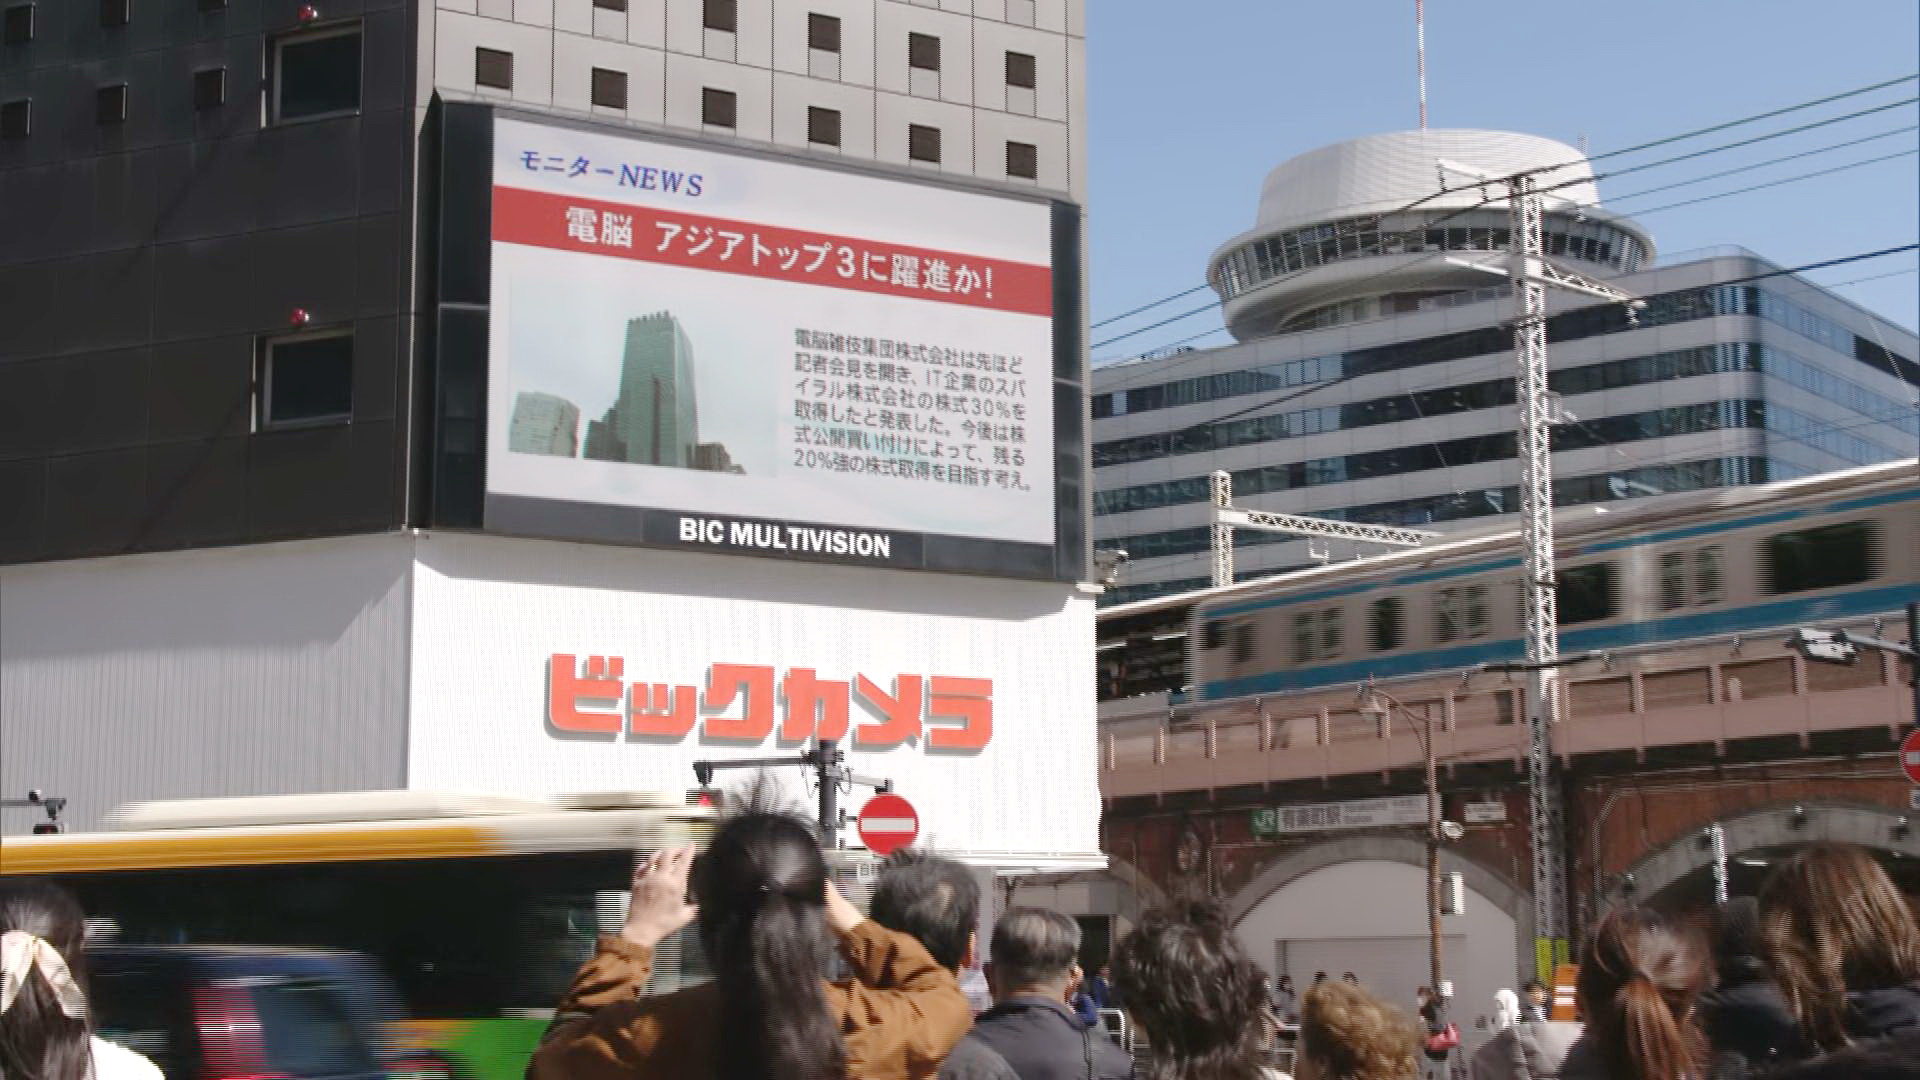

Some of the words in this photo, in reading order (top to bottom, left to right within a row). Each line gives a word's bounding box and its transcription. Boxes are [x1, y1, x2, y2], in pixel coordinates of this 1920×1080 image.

[520, 151, 703, 197] モニターNEWS
[565, 205, 633, 248] 電脳
[679, 517, 724, 544] BIC
[730, 521, 890, 558] MULTIVISION
[548, 653, 993, 754] ビックカメラ
